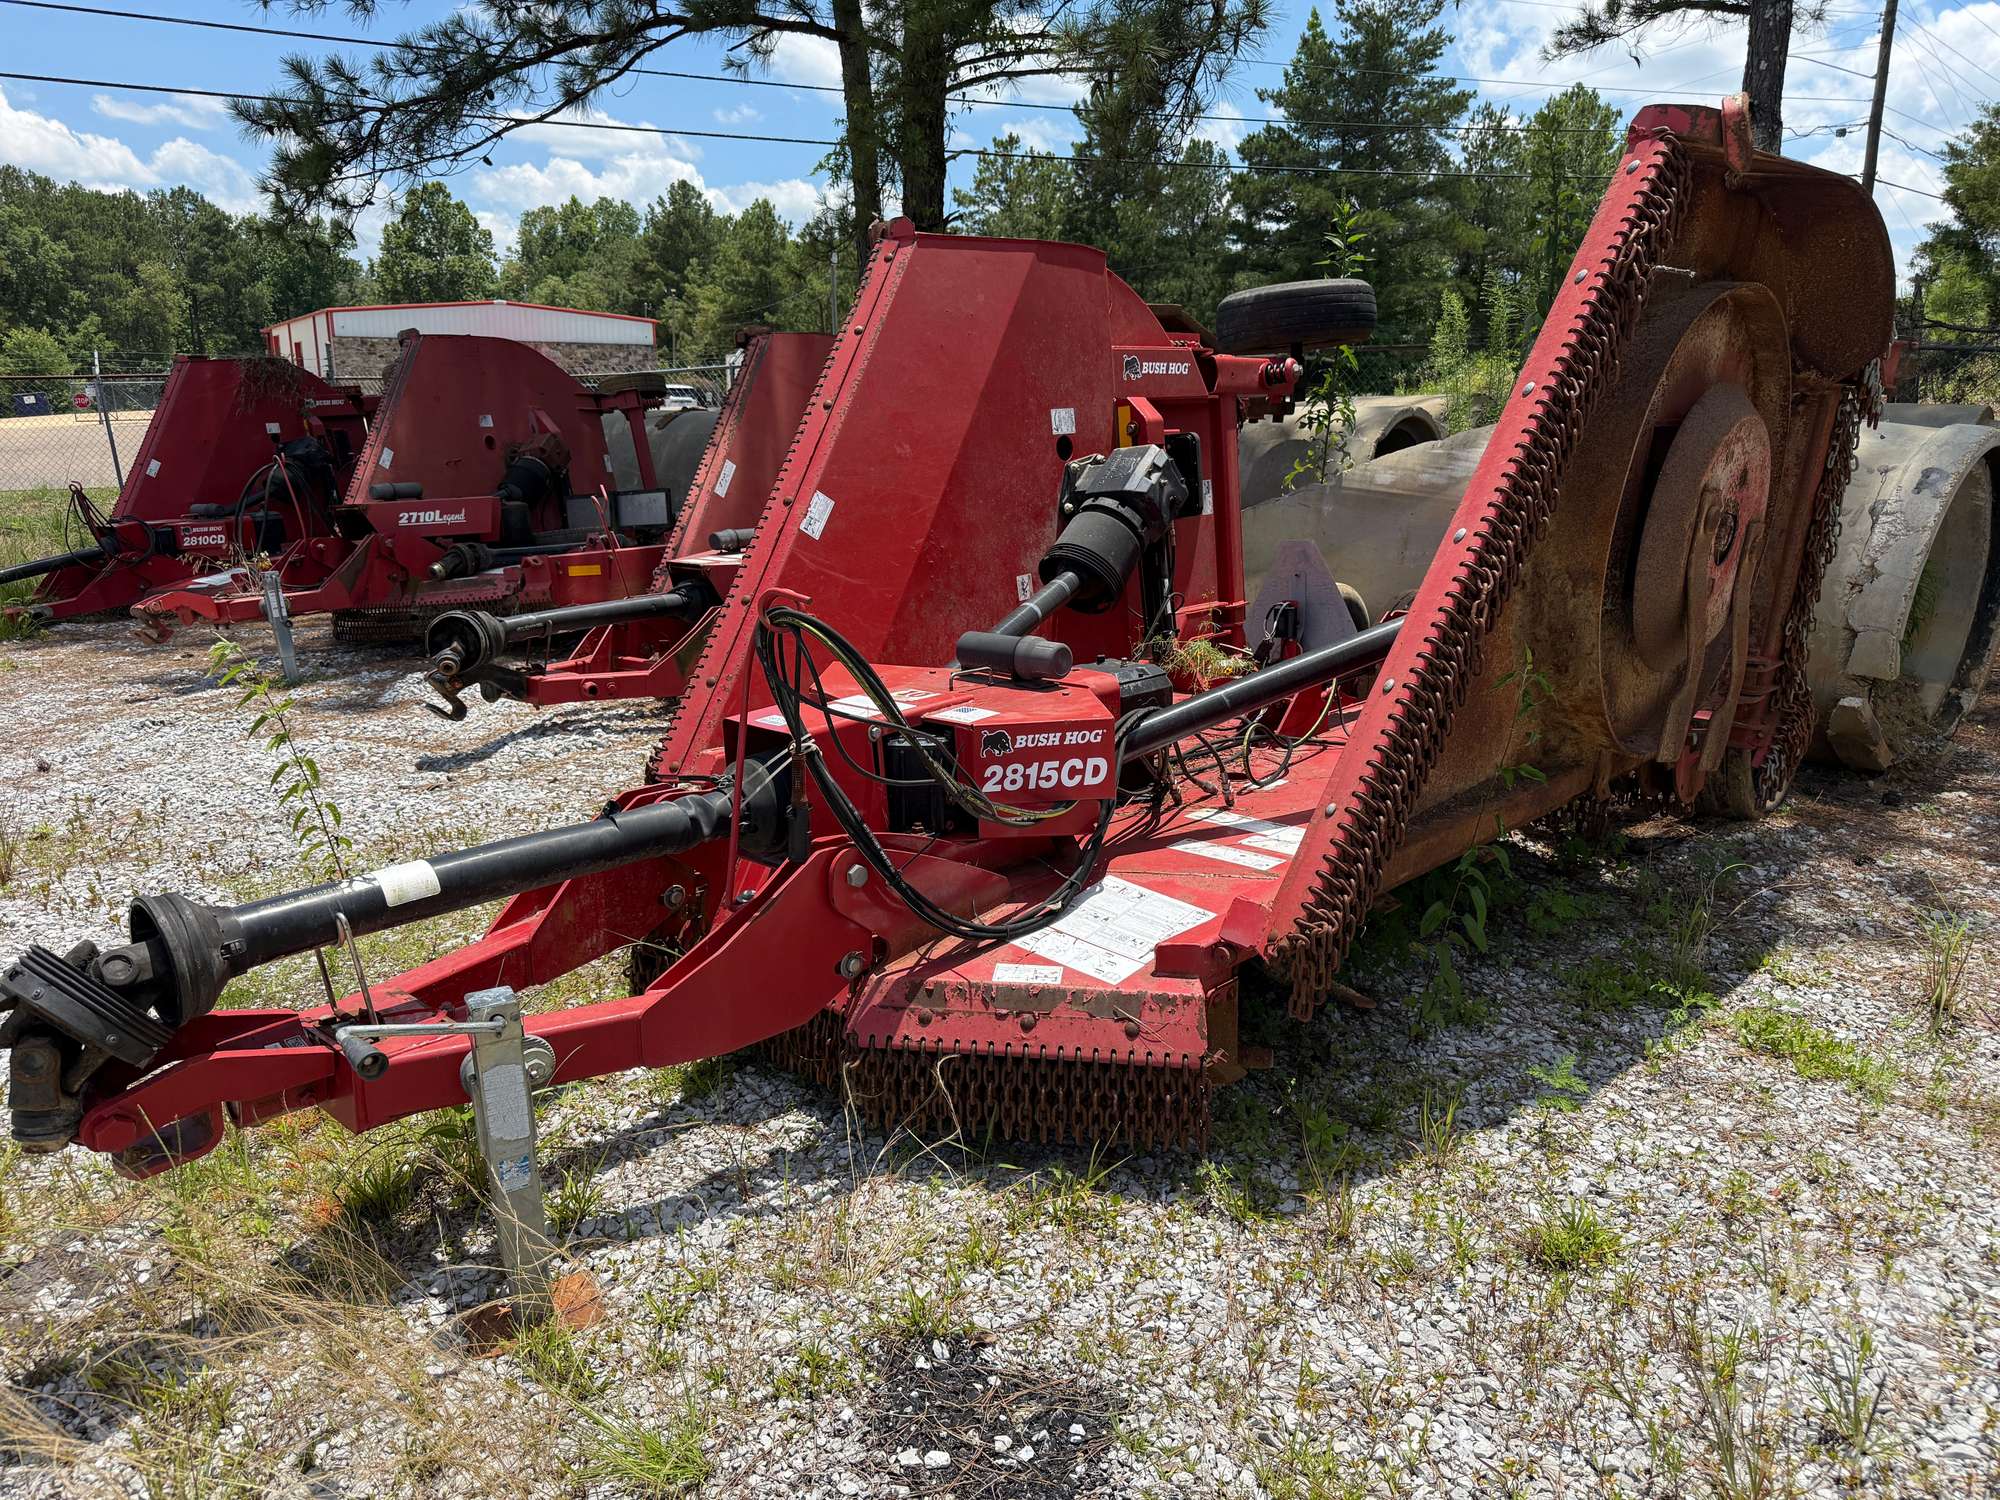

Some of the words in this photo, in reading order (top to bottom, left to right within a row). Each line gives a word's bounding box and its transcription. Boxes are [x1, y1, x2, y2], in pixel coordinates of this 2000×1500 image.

[1142, 362, 1166, 375] BUSH
[1168, 362, 1189, 375] HOG
[183, 535, 226, 546] 2810CD
[1014, 732, 1060, 749] BUSH
[1063, 729, 1103, 745] HOG
[981, 757, 1108, 793] 2815CD
